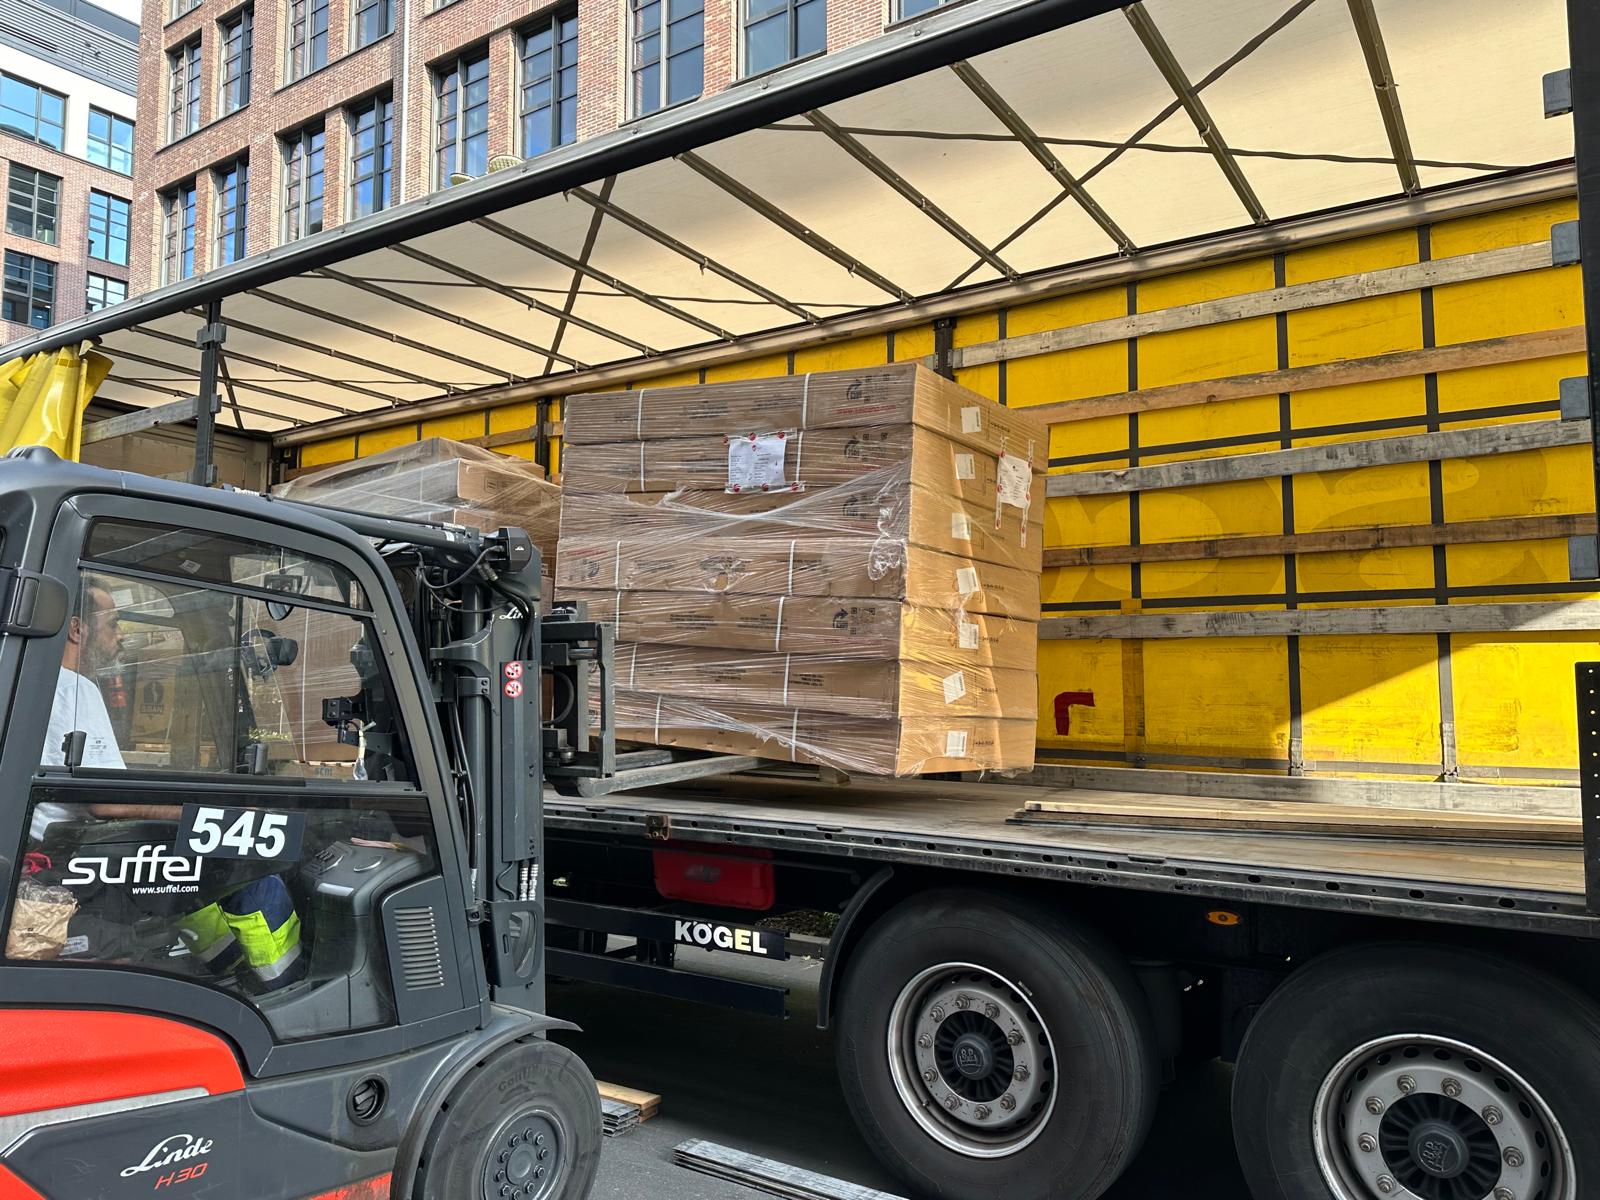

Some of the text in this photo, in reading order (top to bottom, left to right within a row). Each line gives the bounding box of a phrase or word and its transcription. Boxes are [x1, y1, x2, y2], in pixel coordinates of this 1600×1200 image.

[188, 807, 288, 859] 545
[61, 845, 203, 885] suffel
[132, 884, 199, 895] www.suffel.com
[674, 919, 768, 954] KÖGEL
[120, 1133, 214, 1178] Linde
